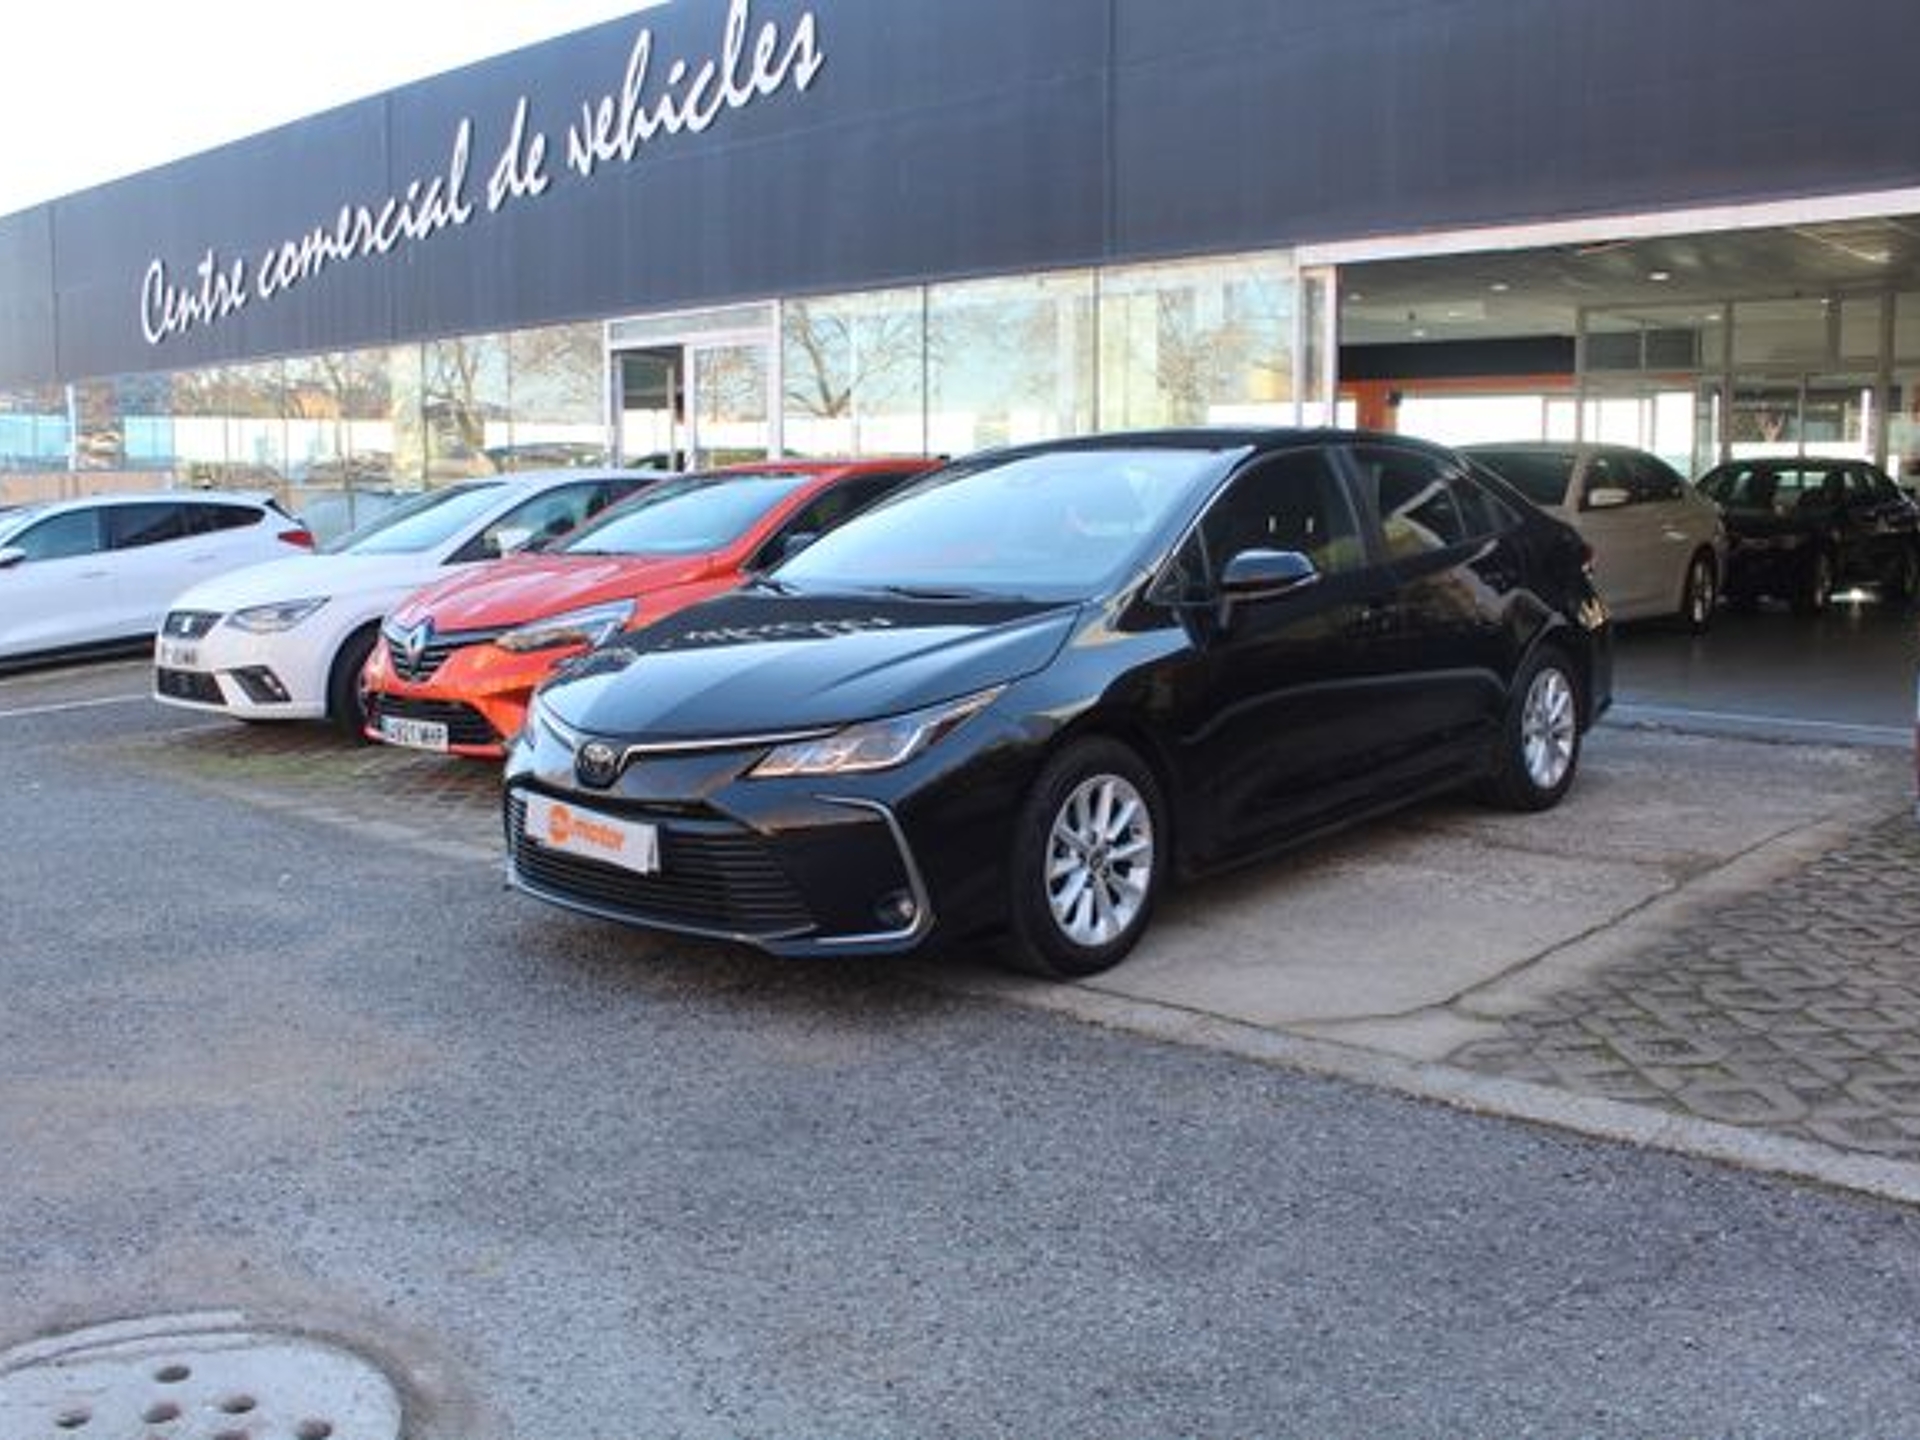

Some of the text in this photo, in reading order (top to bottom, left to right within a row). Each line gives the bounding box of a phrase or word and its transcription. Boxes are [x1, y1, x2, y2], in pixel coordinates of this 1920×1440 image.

[141, 0, 823, 344] Centre comercial de vehicles
